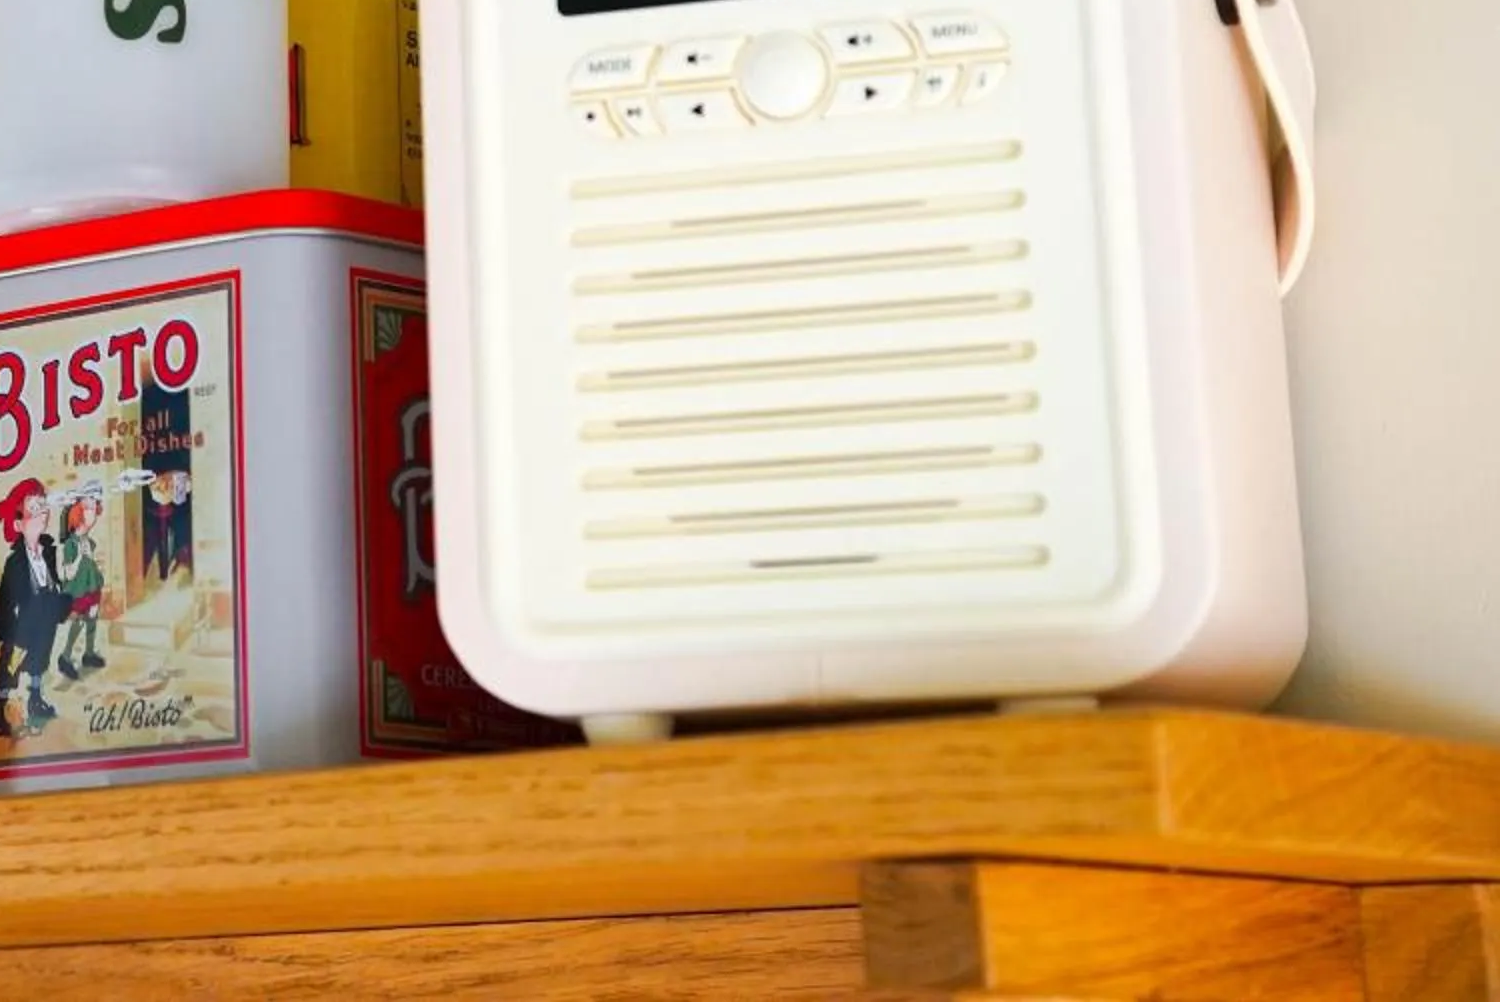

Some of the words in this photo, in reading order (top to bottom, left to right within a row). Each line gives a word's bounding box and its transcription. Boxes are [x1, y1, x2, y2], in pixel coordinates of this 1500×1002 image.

[107, 416, 138, 438] For
[147, 408, 170, 431] all
[73, 440, 125, 466] Meat
[134, 430, 205, 458] Dishes
